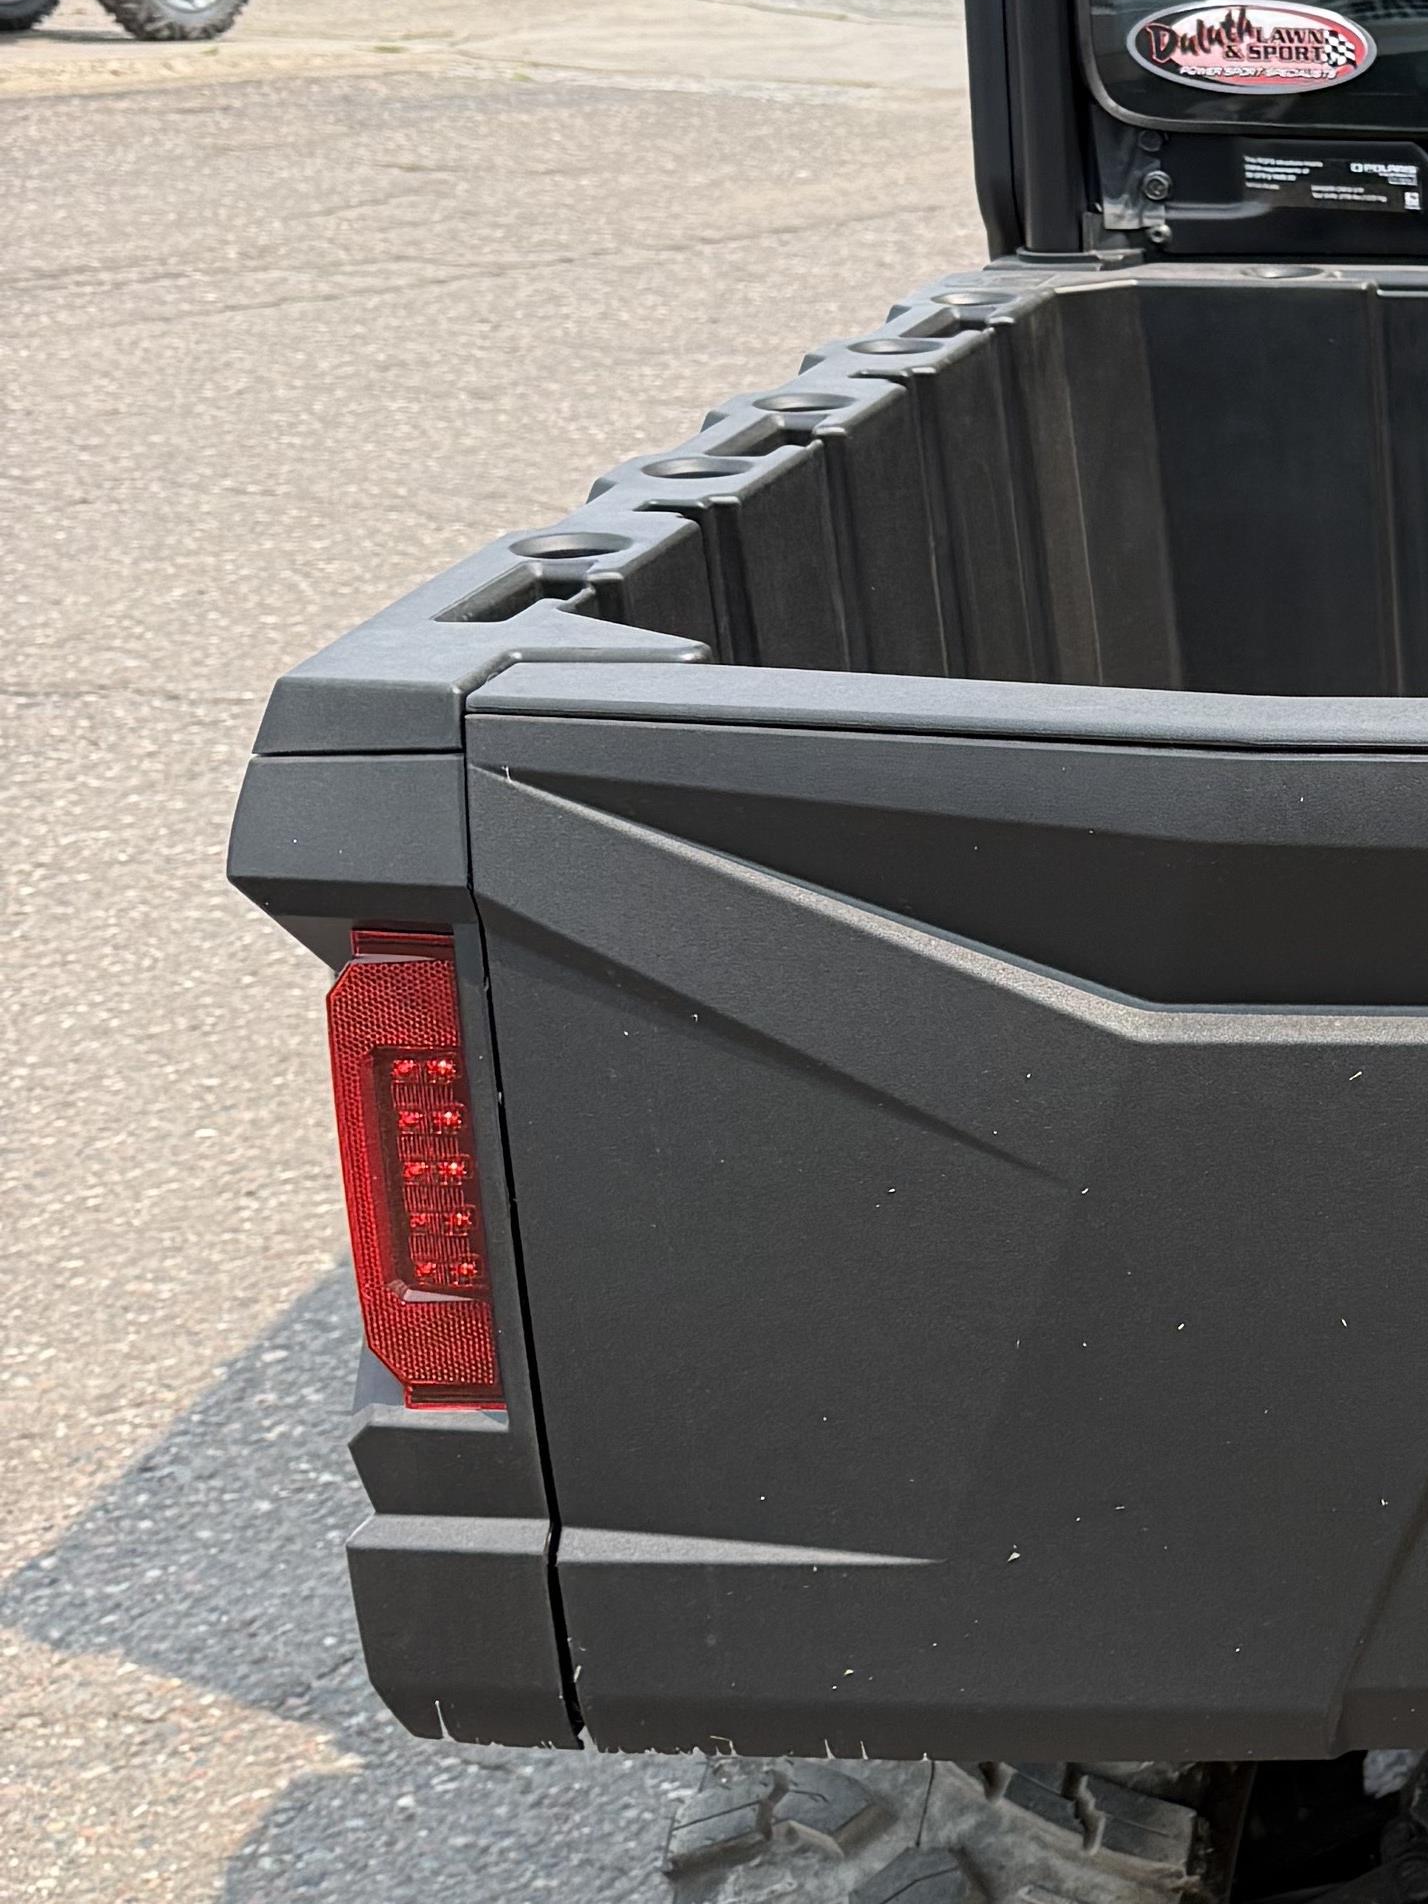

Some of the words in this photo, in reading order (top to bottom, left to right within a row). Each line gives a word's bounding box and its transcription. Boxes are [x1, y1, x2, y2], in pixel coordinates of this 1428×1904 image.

[1145, 5, 1255, 64] Duluth
[1254, 27, 1325, 45] LAWN
[1223, 44, 1243, 62] &
[1247, 44, 1325, 63] SPORT
[1179, 65, 1223, 77] POWER
[1224, 66, 1267, 78] SPORT
[1264, 67, 1338, 79] SPECIALISTS
